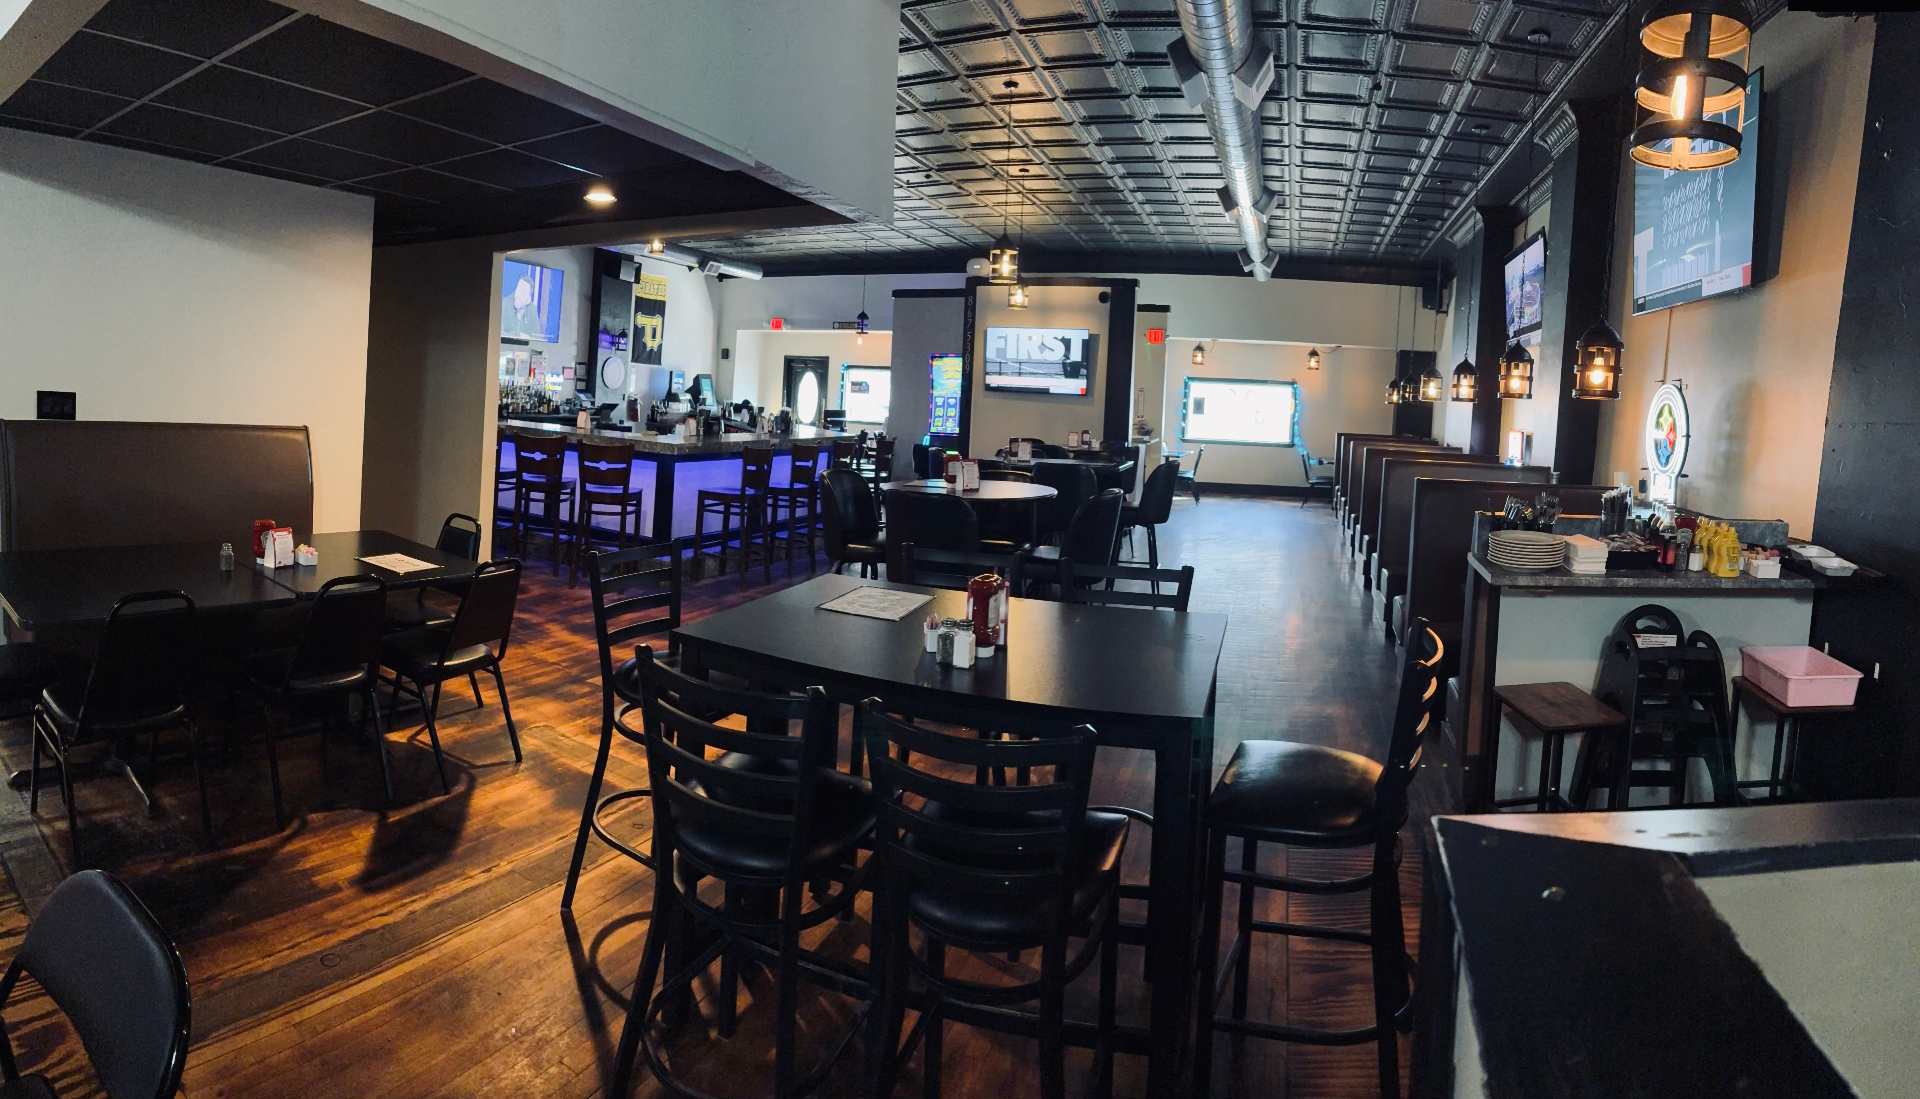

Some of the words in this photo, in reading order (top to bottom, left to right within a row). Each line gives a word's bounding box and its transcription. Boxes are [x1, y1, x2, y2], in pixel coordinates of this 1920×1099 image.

[637, 280, 666, 297] PIRATES
[986, 327, 1089, 362] FIRST
[1149, 329, 1164, 344] EXIT
